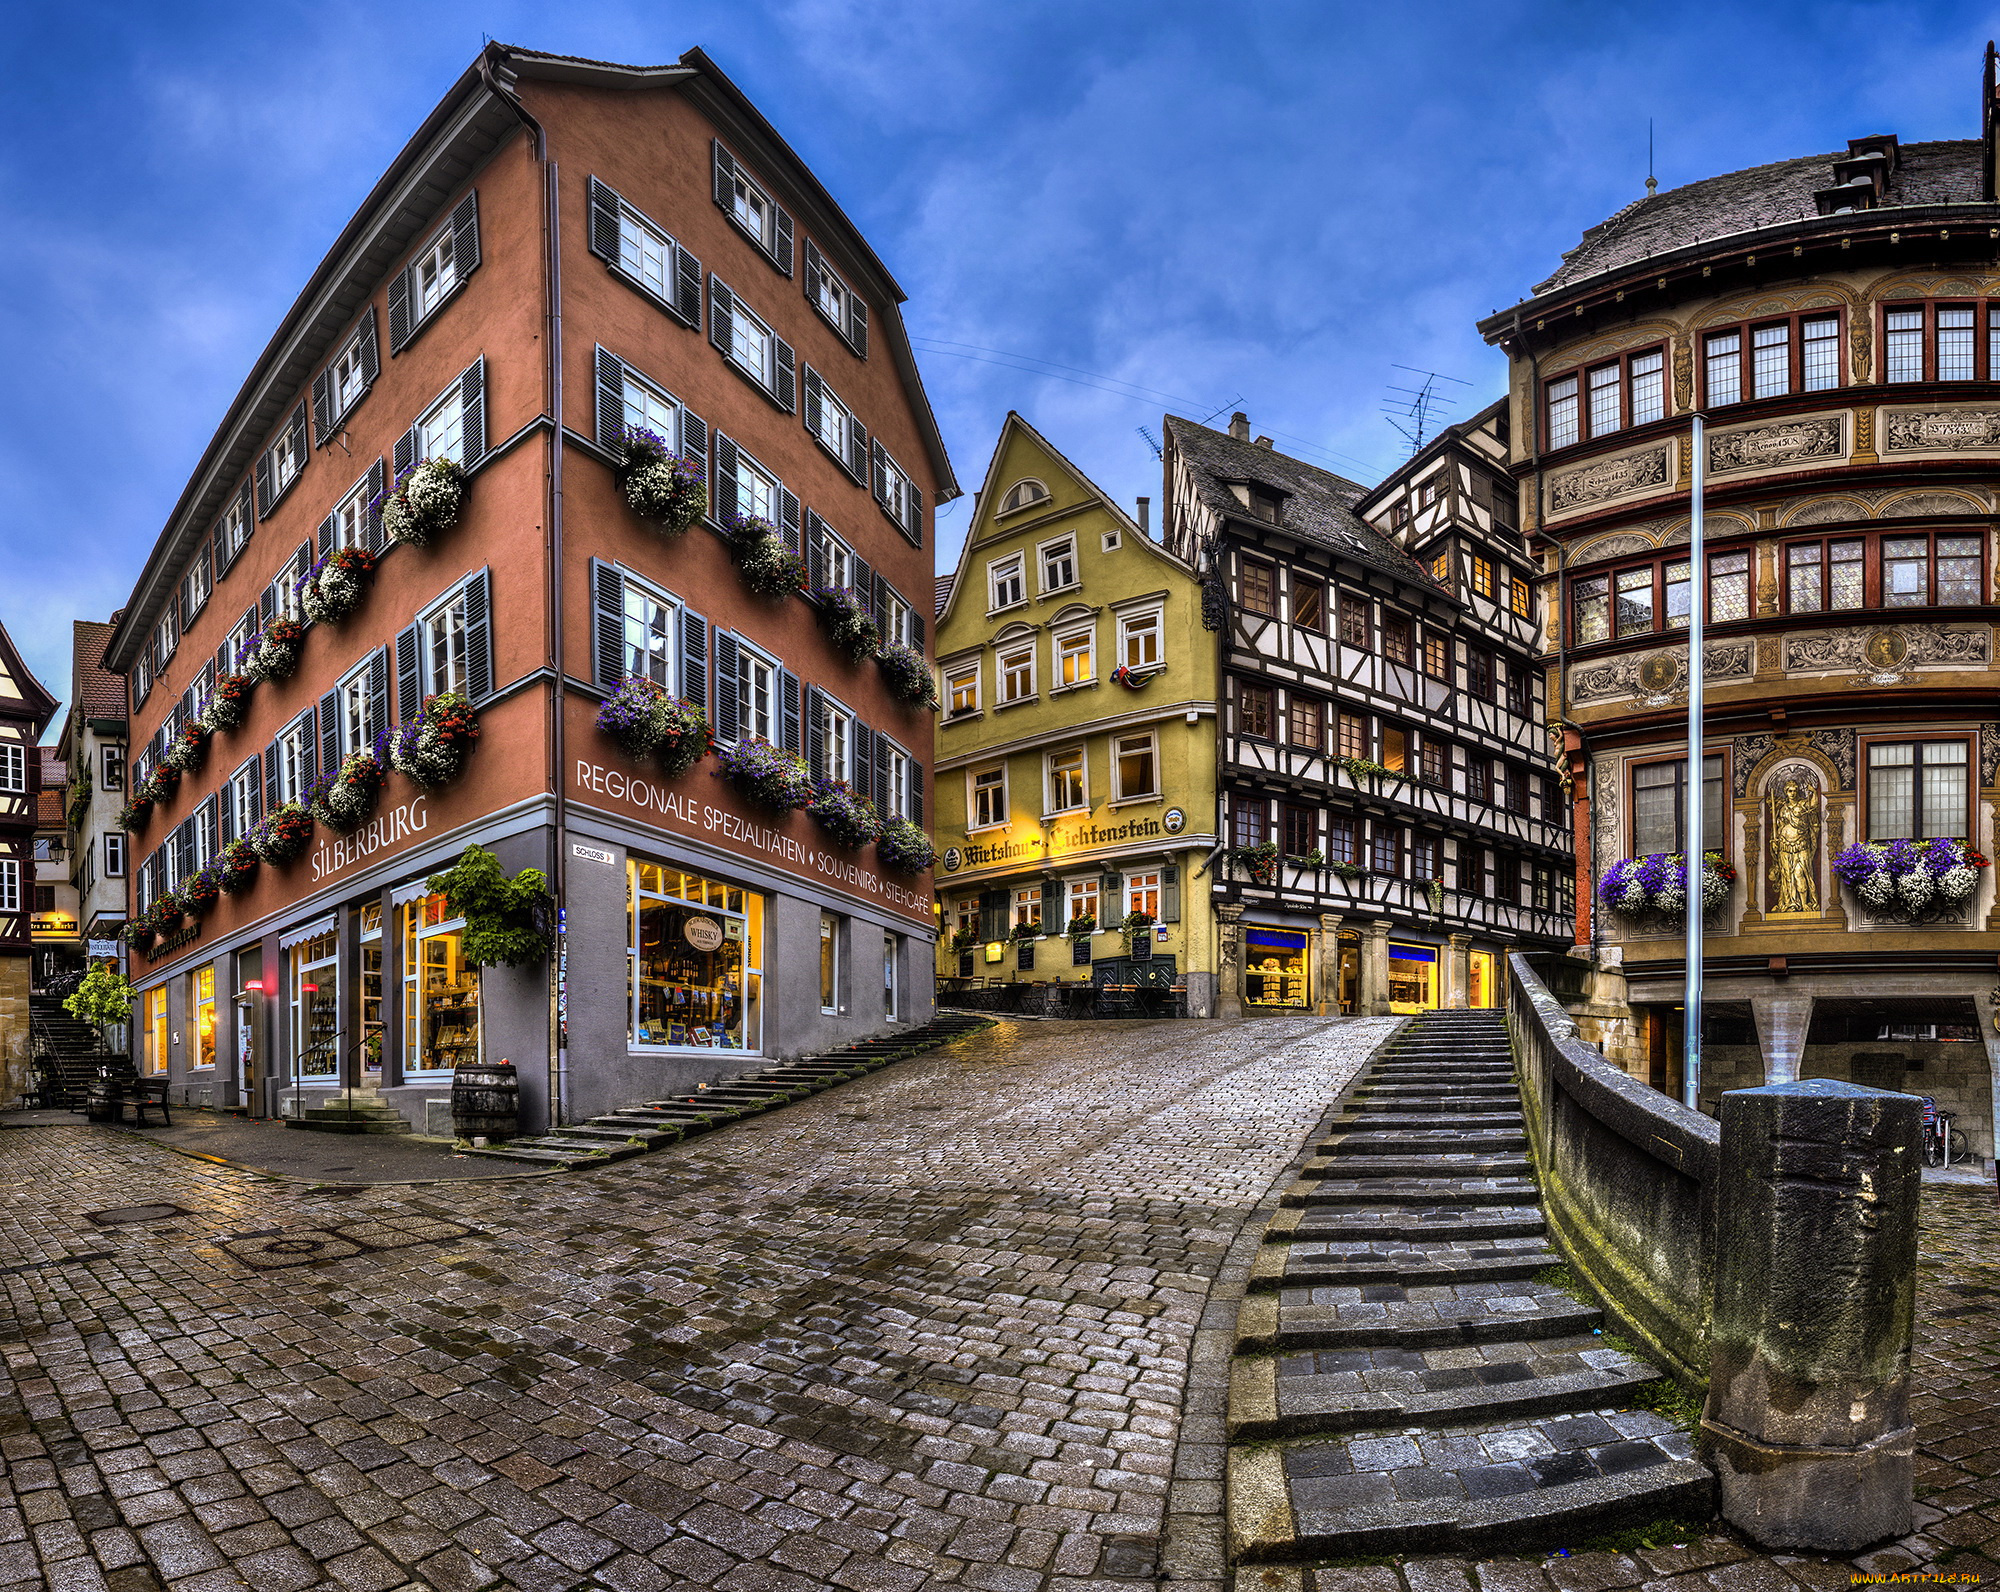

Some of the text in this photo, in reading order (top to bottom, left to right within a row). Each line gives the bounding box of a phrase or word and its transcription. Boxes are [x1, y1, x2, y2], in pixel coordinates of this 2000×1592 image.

[576, 759, 929, 916] REGIONALE SPEZIALITÄTEN SOUVENIRS STEHCAFÉ
[1050, 817, 1161, 852] Lichtenstein
[575, 846, 605, 861] SCHLOSS
[690, 926, 718, 941] WHISKY
